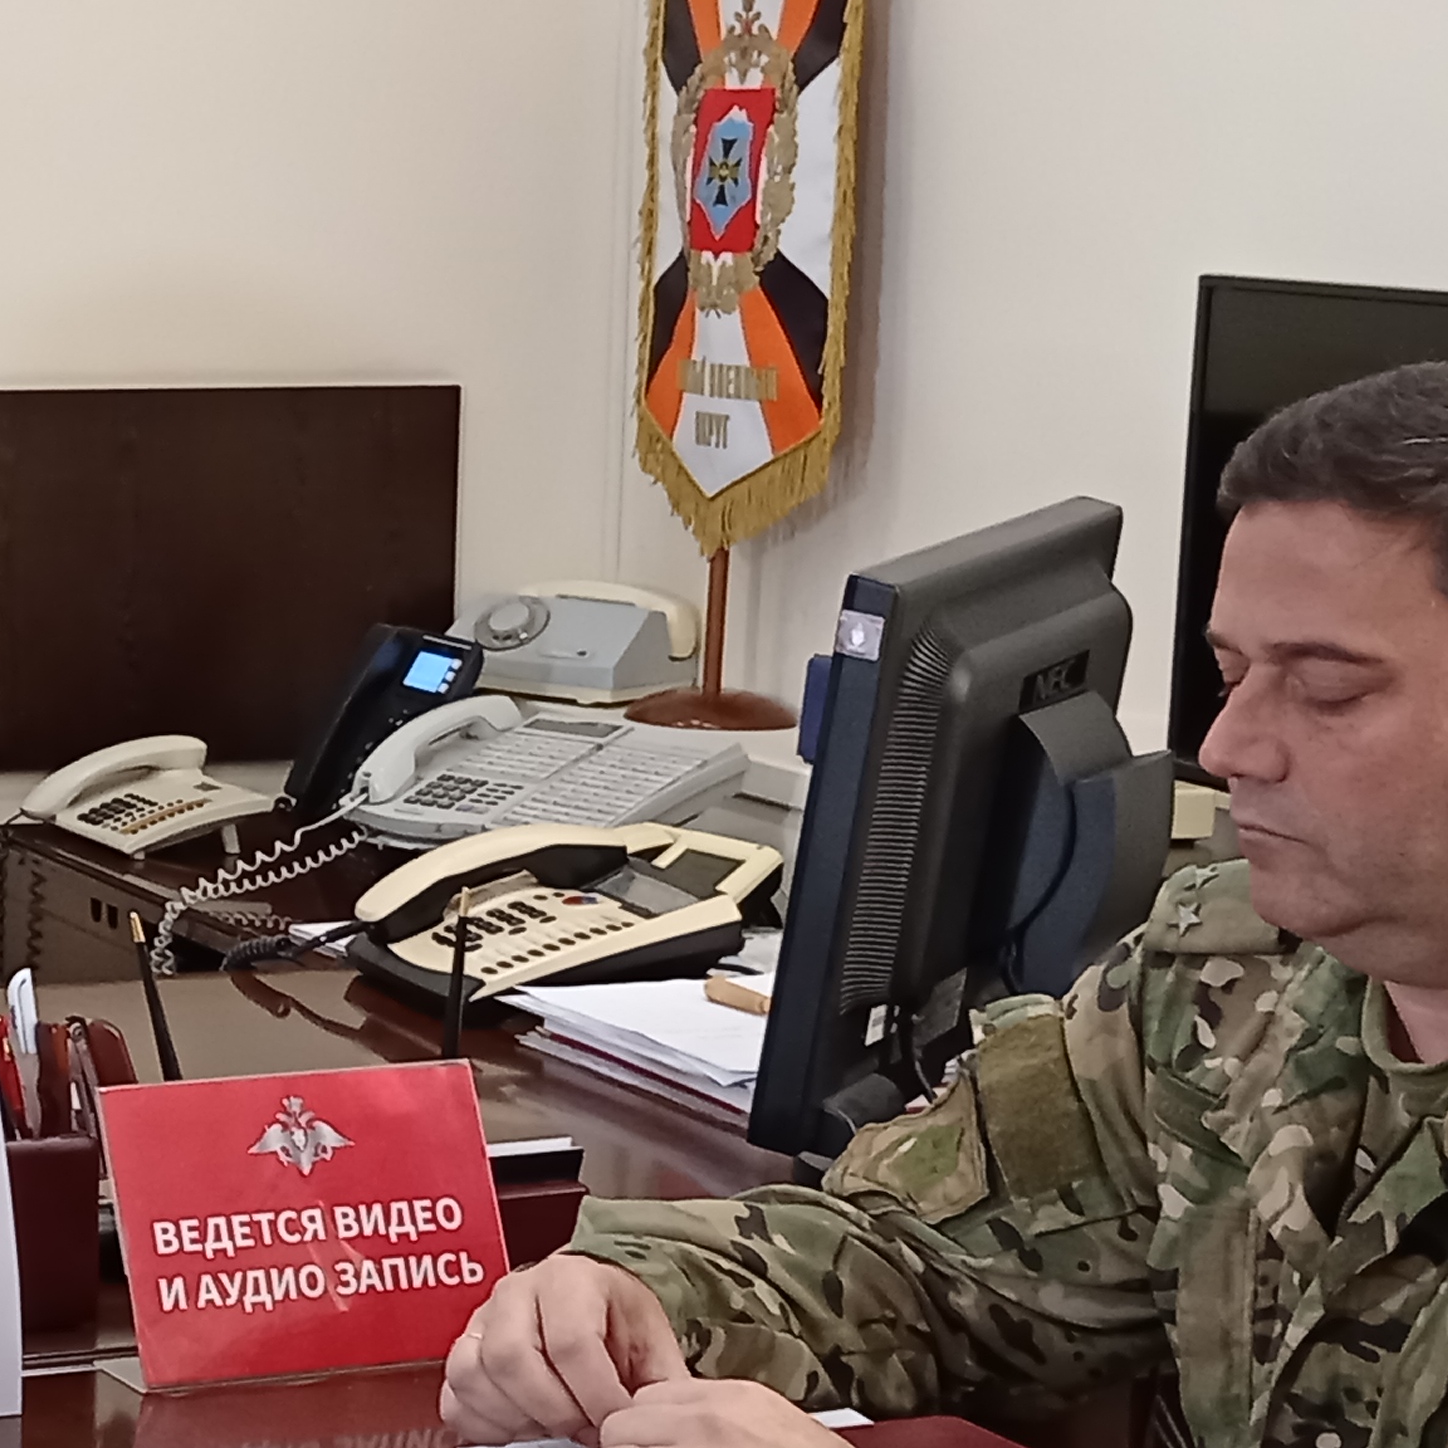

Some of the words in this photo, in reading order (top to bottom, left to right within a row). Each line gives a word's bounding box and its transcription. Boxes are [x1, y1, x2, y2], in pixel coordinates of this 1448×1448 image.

[153, 1207, 327, 1259] ВЕДЕТСЯ
[333, 1197, 462, 1244] ВИДЕО
[157, 1277, 188, 1312] И
[196, 1263, 326, 1313] АУДИО
[333, 1251, 485, 1296] ЗАПИСЬ
